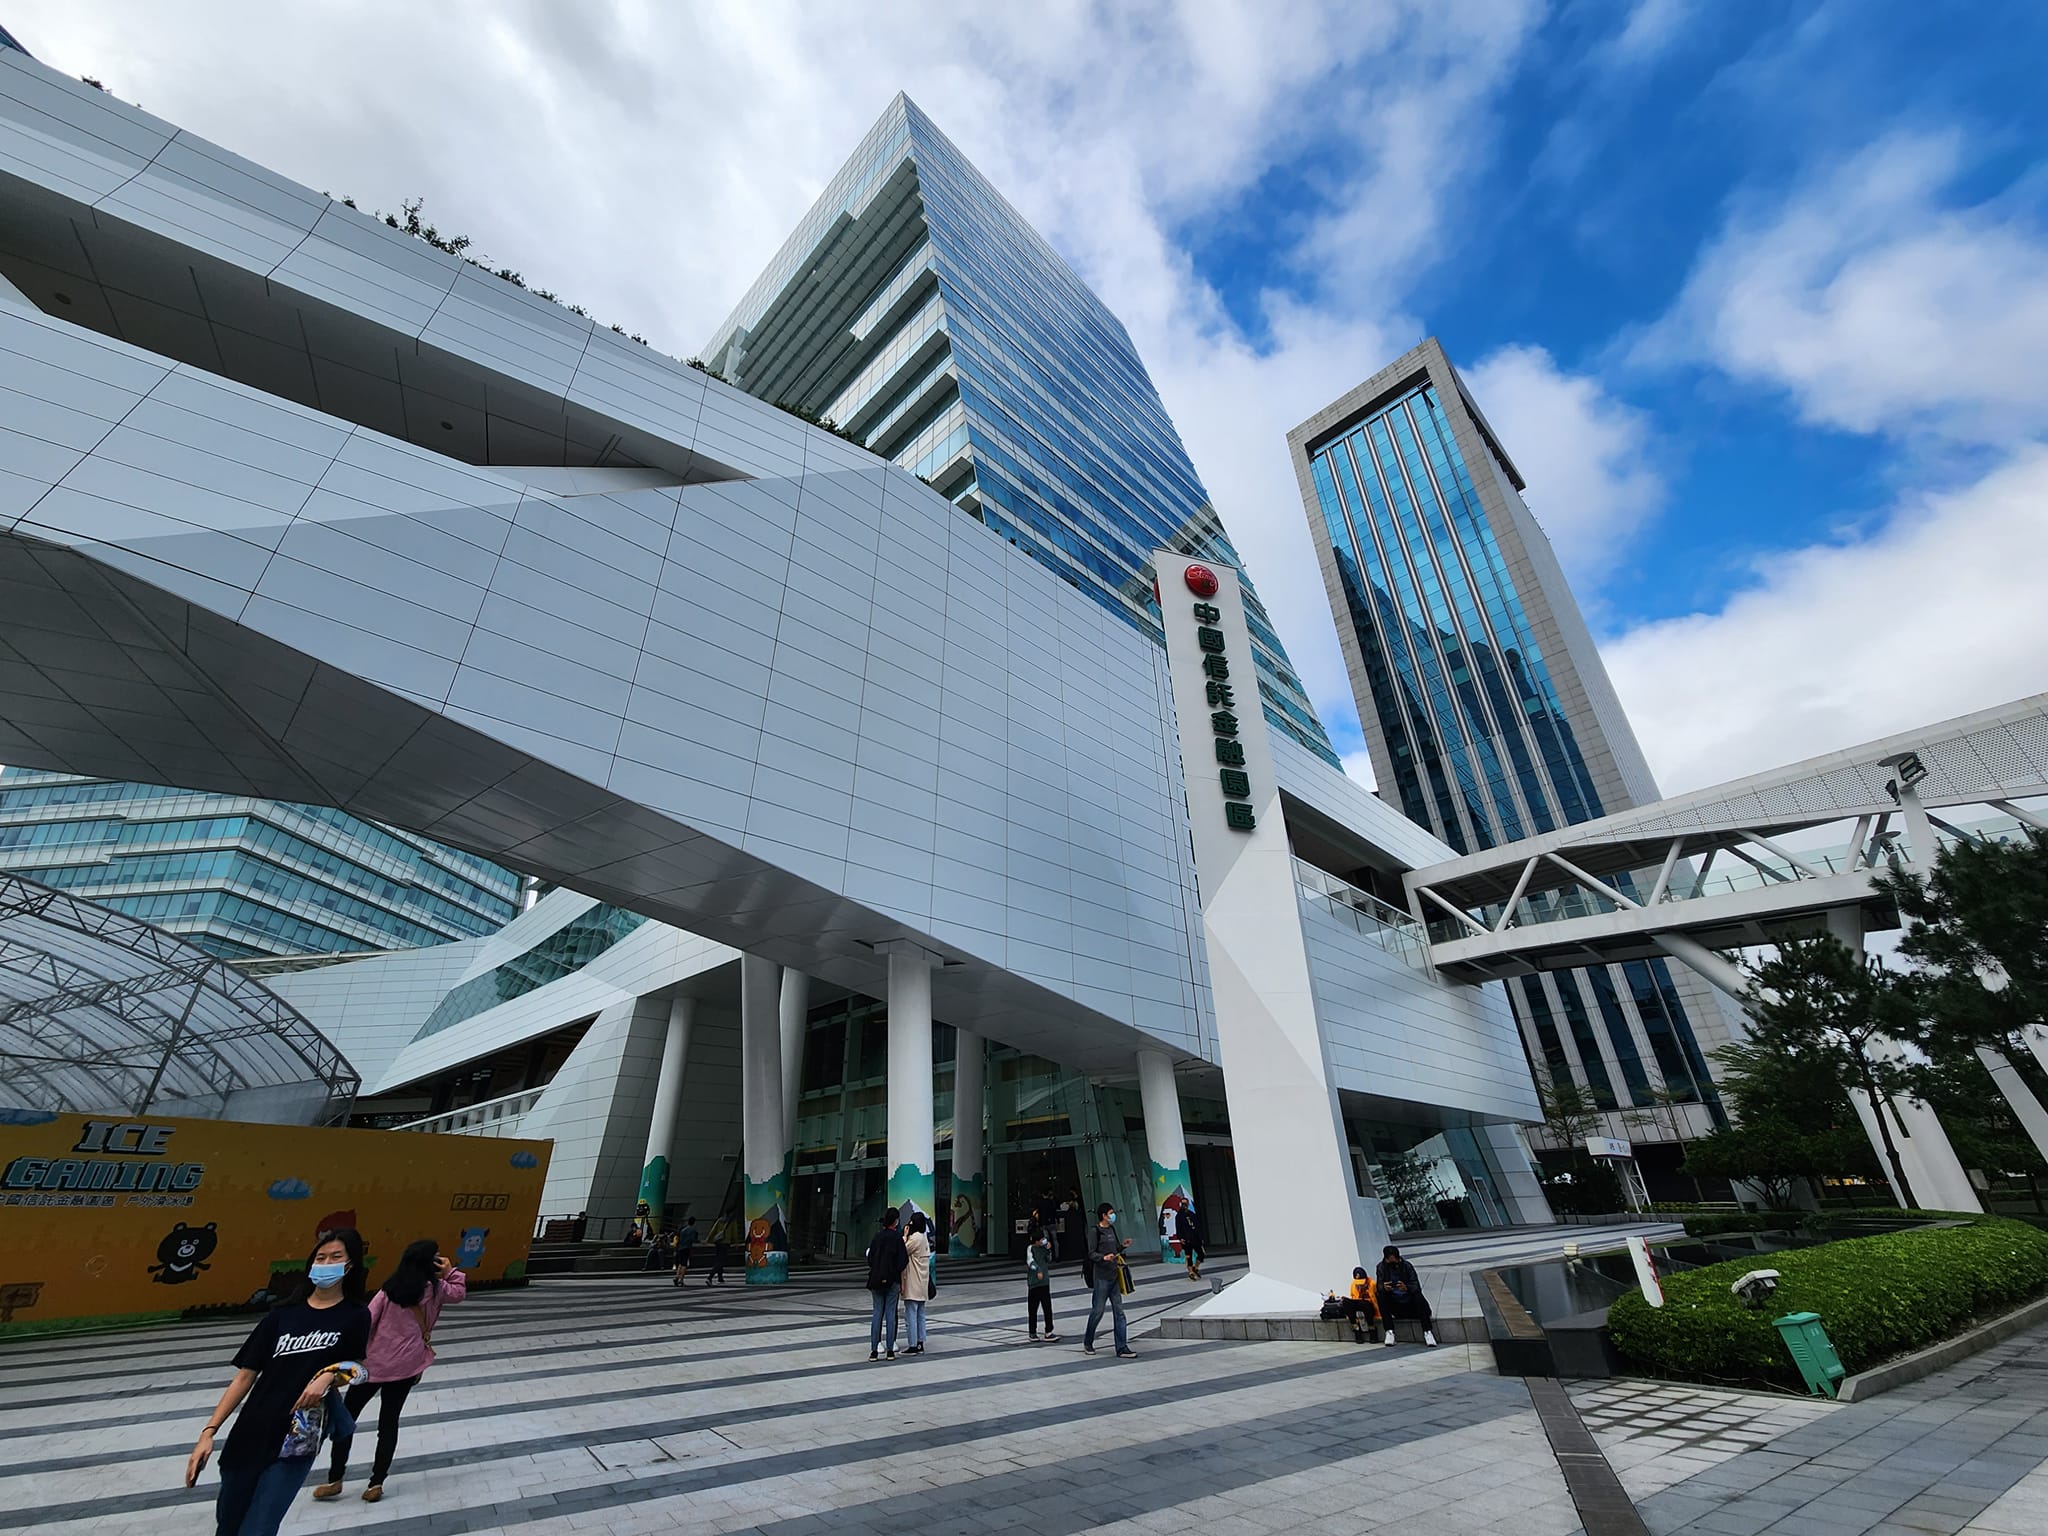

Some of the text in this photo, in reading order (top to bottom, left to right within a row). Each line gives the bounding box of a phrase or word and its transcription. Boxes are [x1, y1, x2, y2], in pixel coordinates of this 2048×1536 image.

[1194, 603, 1257, 831] 中國信託金融園區
[72, 1121, 176, 1155] ICE
[0, 1157, 205, 1192] GAMING
[273, 1330, 341, 1358] Brothers
